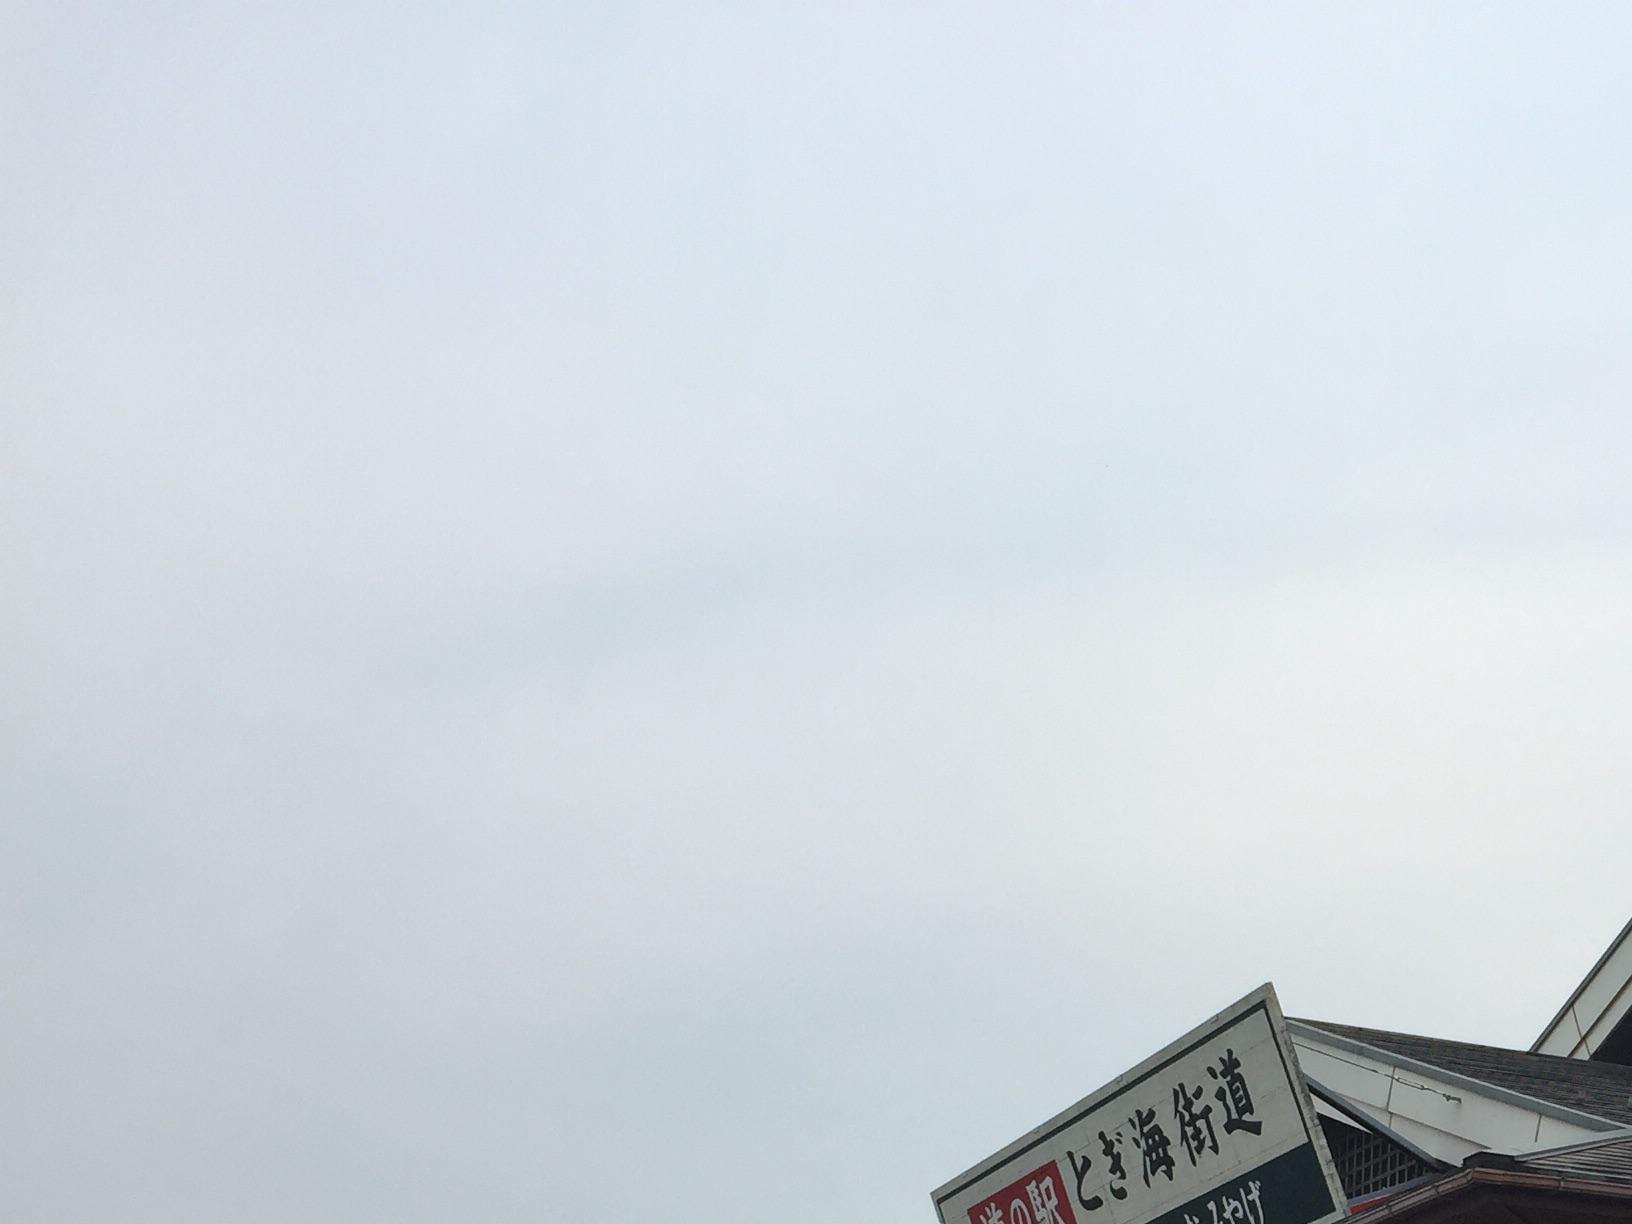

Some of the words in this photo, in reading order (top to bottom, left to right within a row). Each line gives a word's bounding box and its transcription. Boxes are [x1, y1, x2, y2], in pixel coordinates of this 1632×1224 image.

[1067, 1048, 1263, 1212] とぎ海街道
